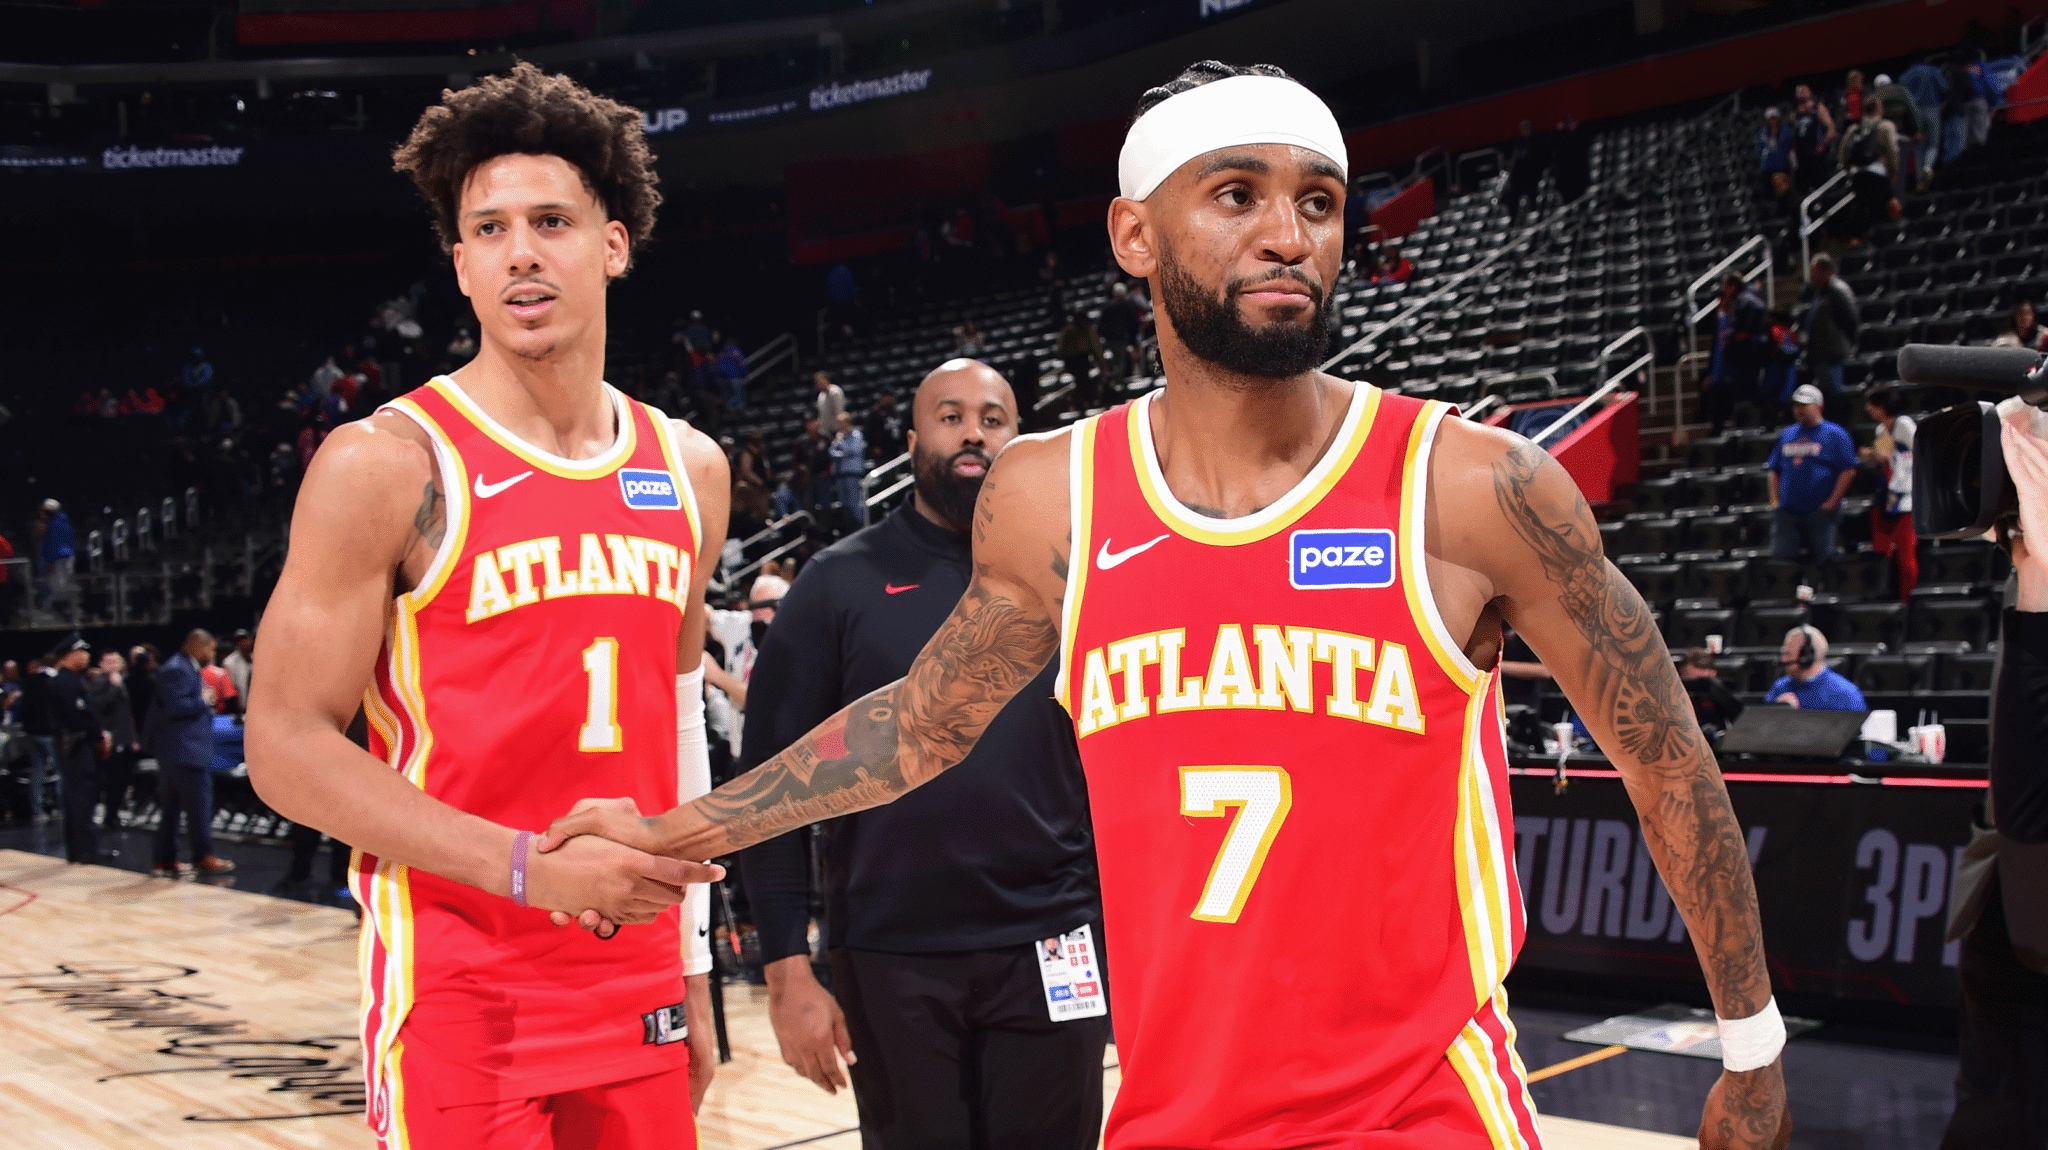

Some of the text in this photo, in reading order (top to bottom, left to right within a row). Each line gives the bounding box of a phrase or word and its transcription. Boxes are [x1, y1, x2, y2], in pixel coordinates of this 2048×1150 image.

[809, 69, 932, 110] ticketmaster
[103, 145, 243, 169] ticketmaster
[625, 480, 673, 499] paze
[1300, 546, 1385, 574] paze
[578, 636, 623, 752] 1
[1077, 624, 1426, 739] ATLANTA
[1177, 764, 1293, 924] 7
[1847, 828, 1964, 968] 3P
